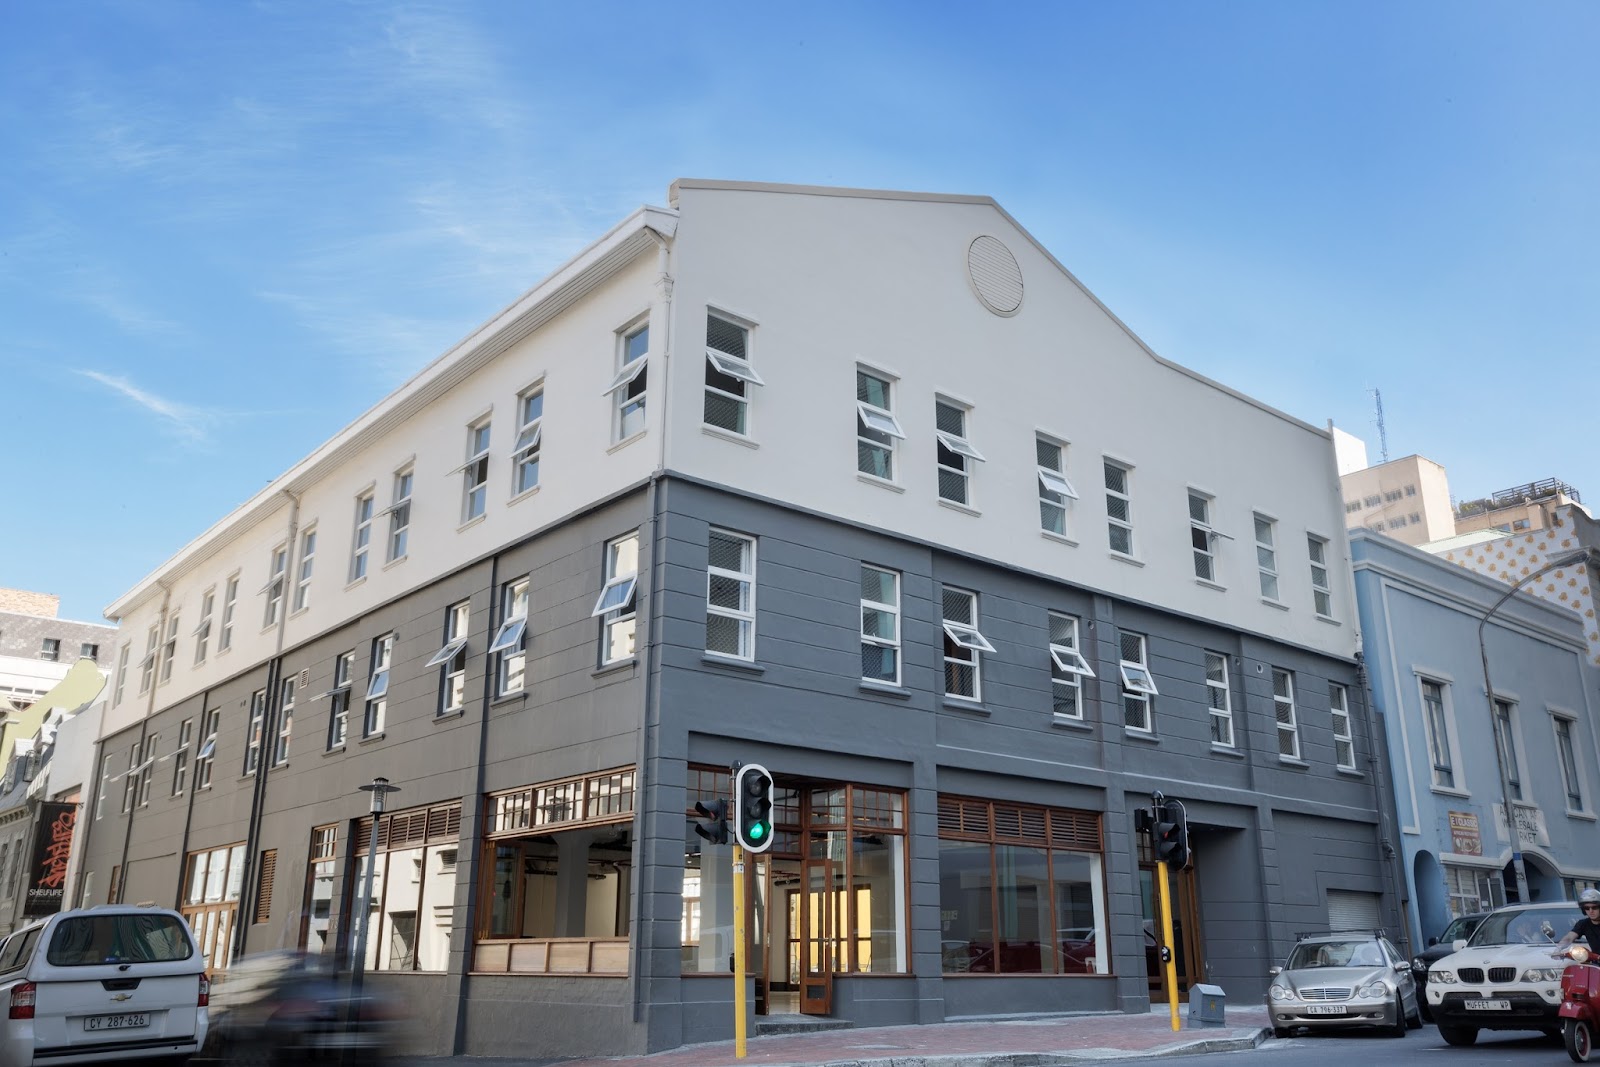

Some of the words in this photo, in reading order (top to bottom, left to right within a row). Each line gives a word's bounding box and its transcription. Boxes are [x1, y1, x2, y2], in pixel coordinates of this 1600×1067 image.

[29, 889, 63, 897] SHELFLIFE
[1466, 1001, 1490, 1009] MUFFET
[1500, 1001, 1509, 1009] WP
[90, 1018, 102, 1028] CY
[107, 1015, 145, 1028] 287-626
